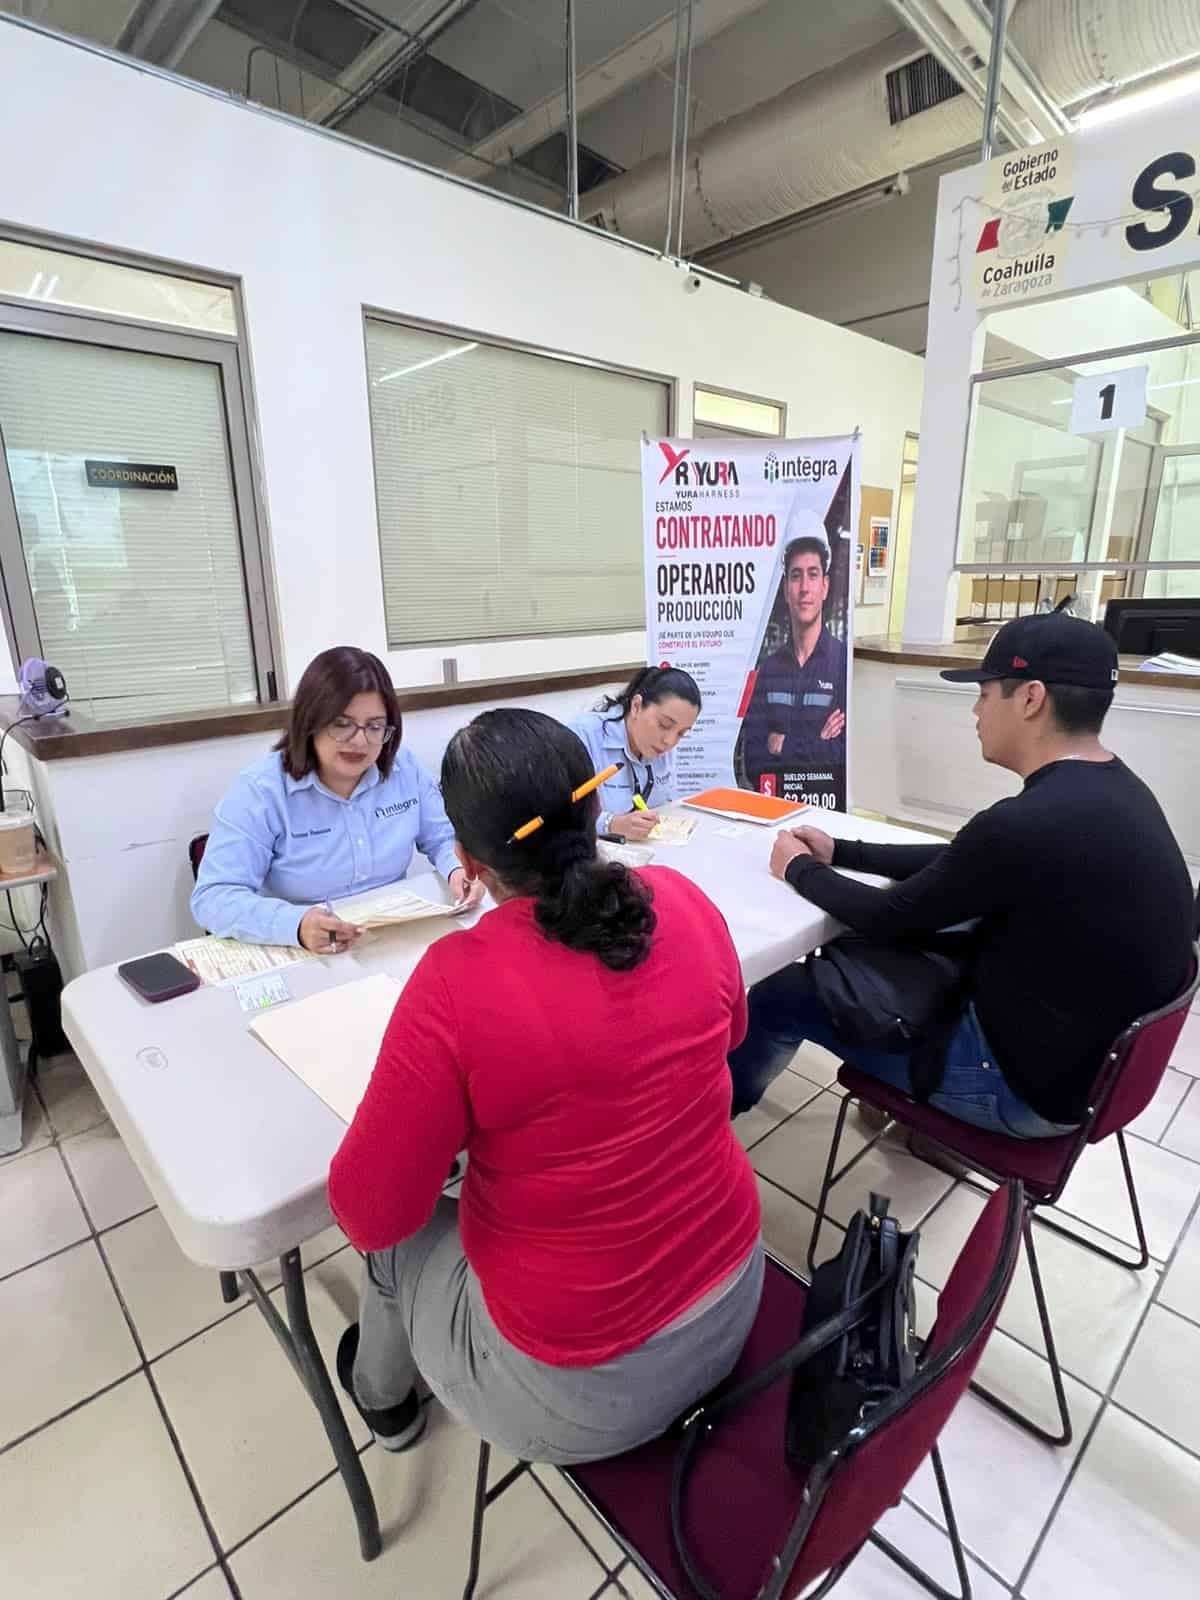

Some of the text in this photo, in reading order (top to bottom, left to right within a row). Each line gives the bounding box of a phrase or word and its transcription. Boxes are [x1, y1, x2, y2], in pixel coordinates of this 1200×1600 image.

[1003, 149, 1058, 178] Gobierno
[1001, 165, 1057, 193] del Estado
[1125, 152, 1200, 251] S
[983, 253, 1055, 284] Coahuila
[993, 273, 1053, 298] Zaragoza
[1099, 384, 1116, 420] 1
[88, 467, 176, 484] COORDINACIÓN
[691, 461, 739, 486] YURA
[655, 501, 693, 513] ESTAMOS
[675, 489, 740, 499] YURA HARNESS
[656, 513, 777, 550] CONTRATANDO
[657, 561, 756, 597] OPERARIOS
[657, 595, 744, 623] PRODUCCIÓN
[783, 772, 834, 782] SUELDO SEMANAL
[783, 783, 804, 791] INICIAL
